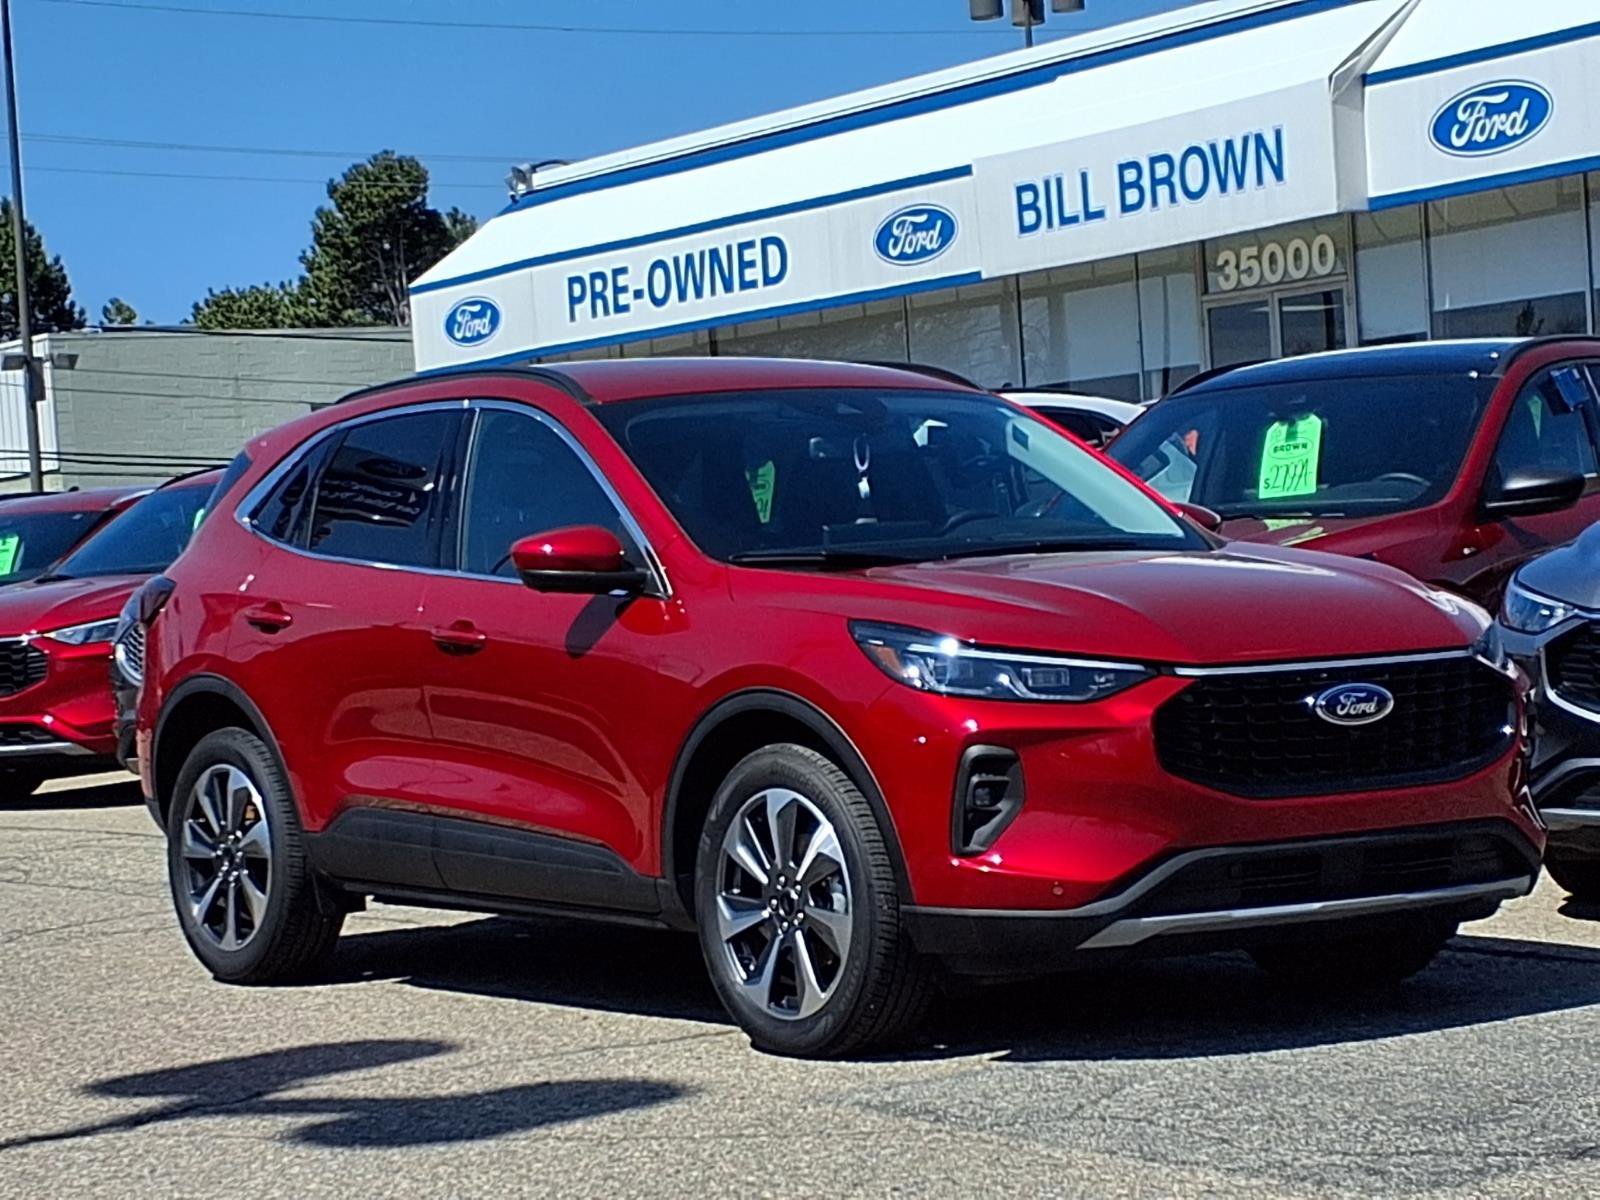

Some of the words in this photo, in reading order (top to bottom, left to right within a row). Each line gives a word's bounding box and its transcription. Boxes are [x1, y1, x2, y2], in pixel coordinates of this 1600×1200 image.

[1450, 91, 1530, 148] Ford
[1016, 169, 1105, 236] BILL
[1117, 127, 1285, 214] BROWN
[888, 212, 943, 257] Ford
[1217, 234, 1336, 290] 35000
[568, 236, 788, 322] PRE-OWNED
[454, 305, 491, 338] Ford
[1336, 692, 1378, 716] Ford
